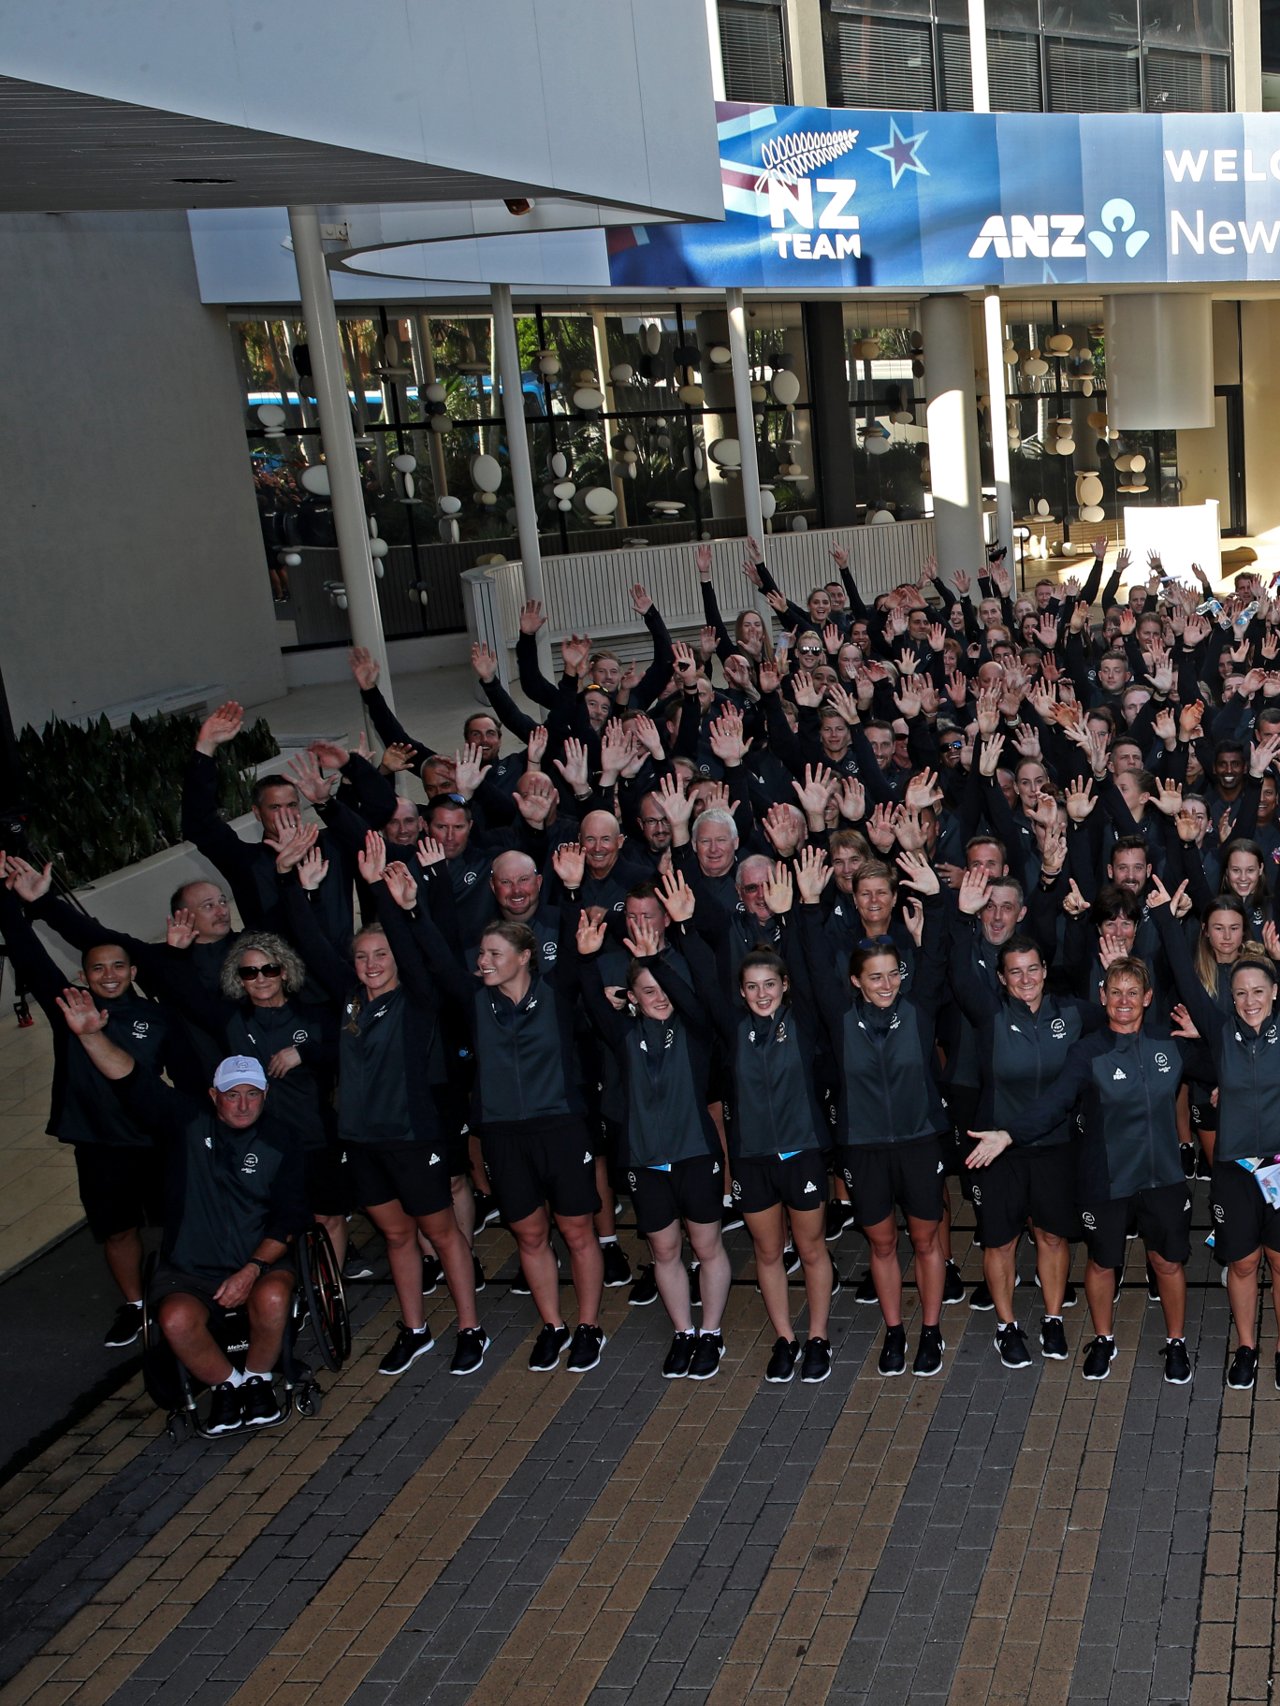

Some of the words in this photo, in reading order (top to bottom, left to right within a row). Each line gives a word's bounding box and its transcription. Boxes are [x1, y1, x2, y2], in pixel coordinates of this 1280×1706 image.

[768, 178, 860, 230] NZ
[773, 233, 861, 260] TEAM
[968, 215, 1087, 258] ANZ
